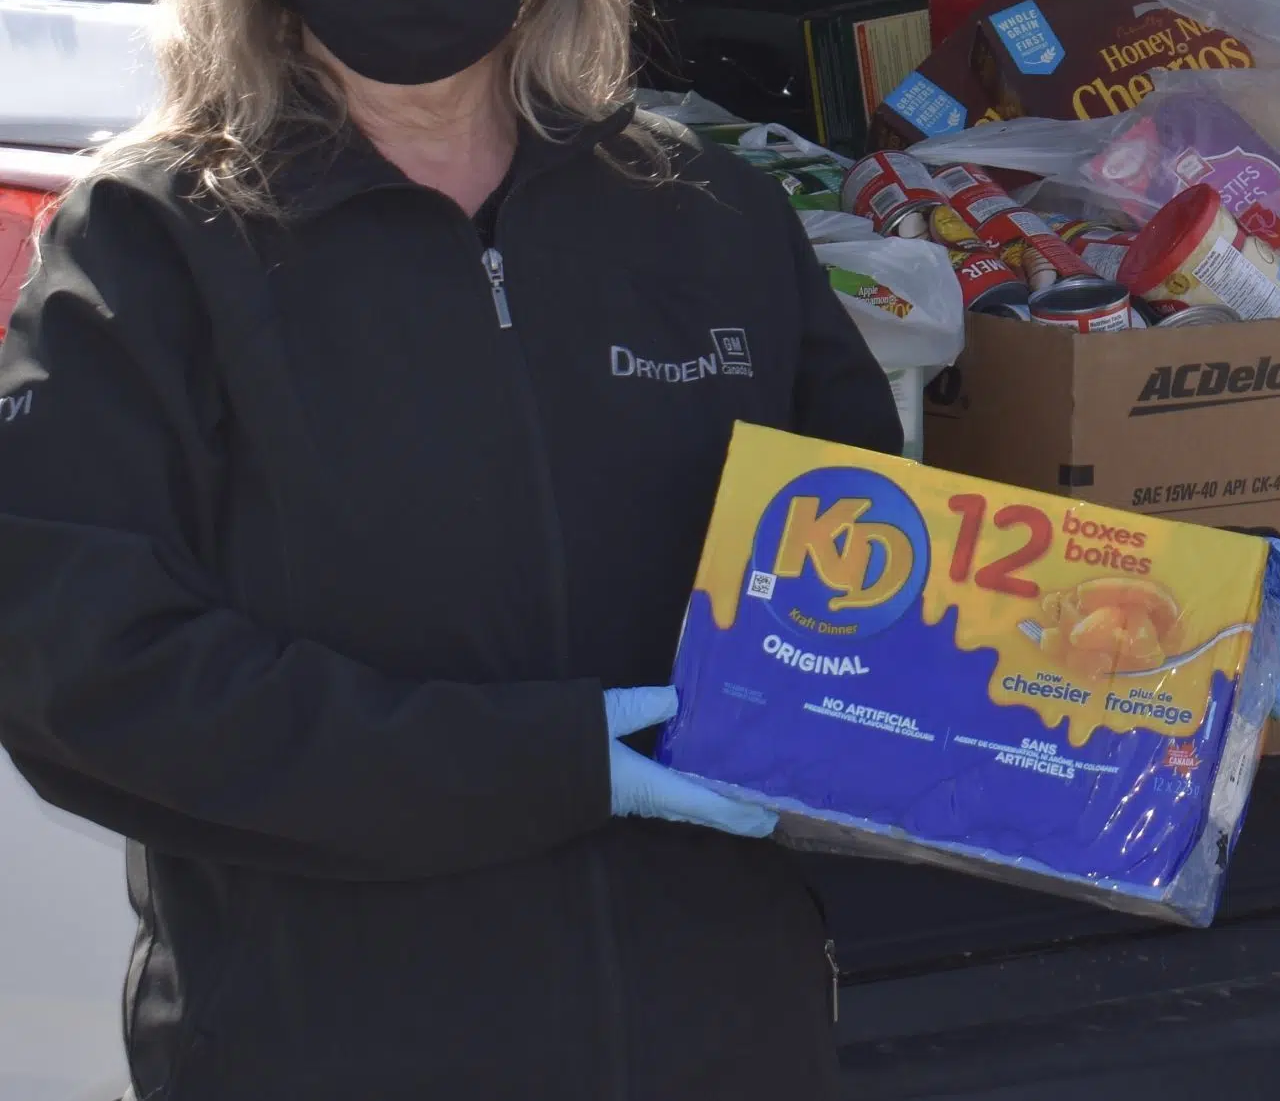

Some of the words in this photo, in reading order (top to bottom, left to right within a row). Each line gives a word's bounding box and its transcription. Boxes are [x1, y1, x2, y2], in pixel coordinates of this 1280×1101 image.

[998, 9, 1038, 32] WHOLE
[1007, 20, 1040, 40] GRAIN
[1016, 33, 1045, 52] FIRST
[1100, 28, 1176, 72] Honey
[722, 337, 743, 352] GM
[1132, 486, 1161, 506] SAE
[1164, 479, 1218, 505] 15W-40
[1222, 478, 1248, 497] API
[1062, 509, 1148, 549] boxes
[773, 496, 915, 612] KD
[948, 493, 1054, 598] 12
[1065, 537, 1153, 575] boîtes
[788, 608, 816, 630] Kraft
[818, 621, 858, 636] Dinner
[763, 634, 870, 676] ORIGINAL
[1001, 672, 1092, 707] cheesier
[1036, 671, 1063, 684] now
[1104, 692, 1194, 726] fromage
[1129, 687, 1156, 704] plus
[1157, 690, 1173, 703] de
[822, 696, 845, 712] NO
[846, 703, 920, 731] ARTIFICIAL
[1020, 737, 1058, 755] SANS
[994, 751, 1077, 780] ARTIFICIELS
[1169, 757, 1195, 766] CANADA
